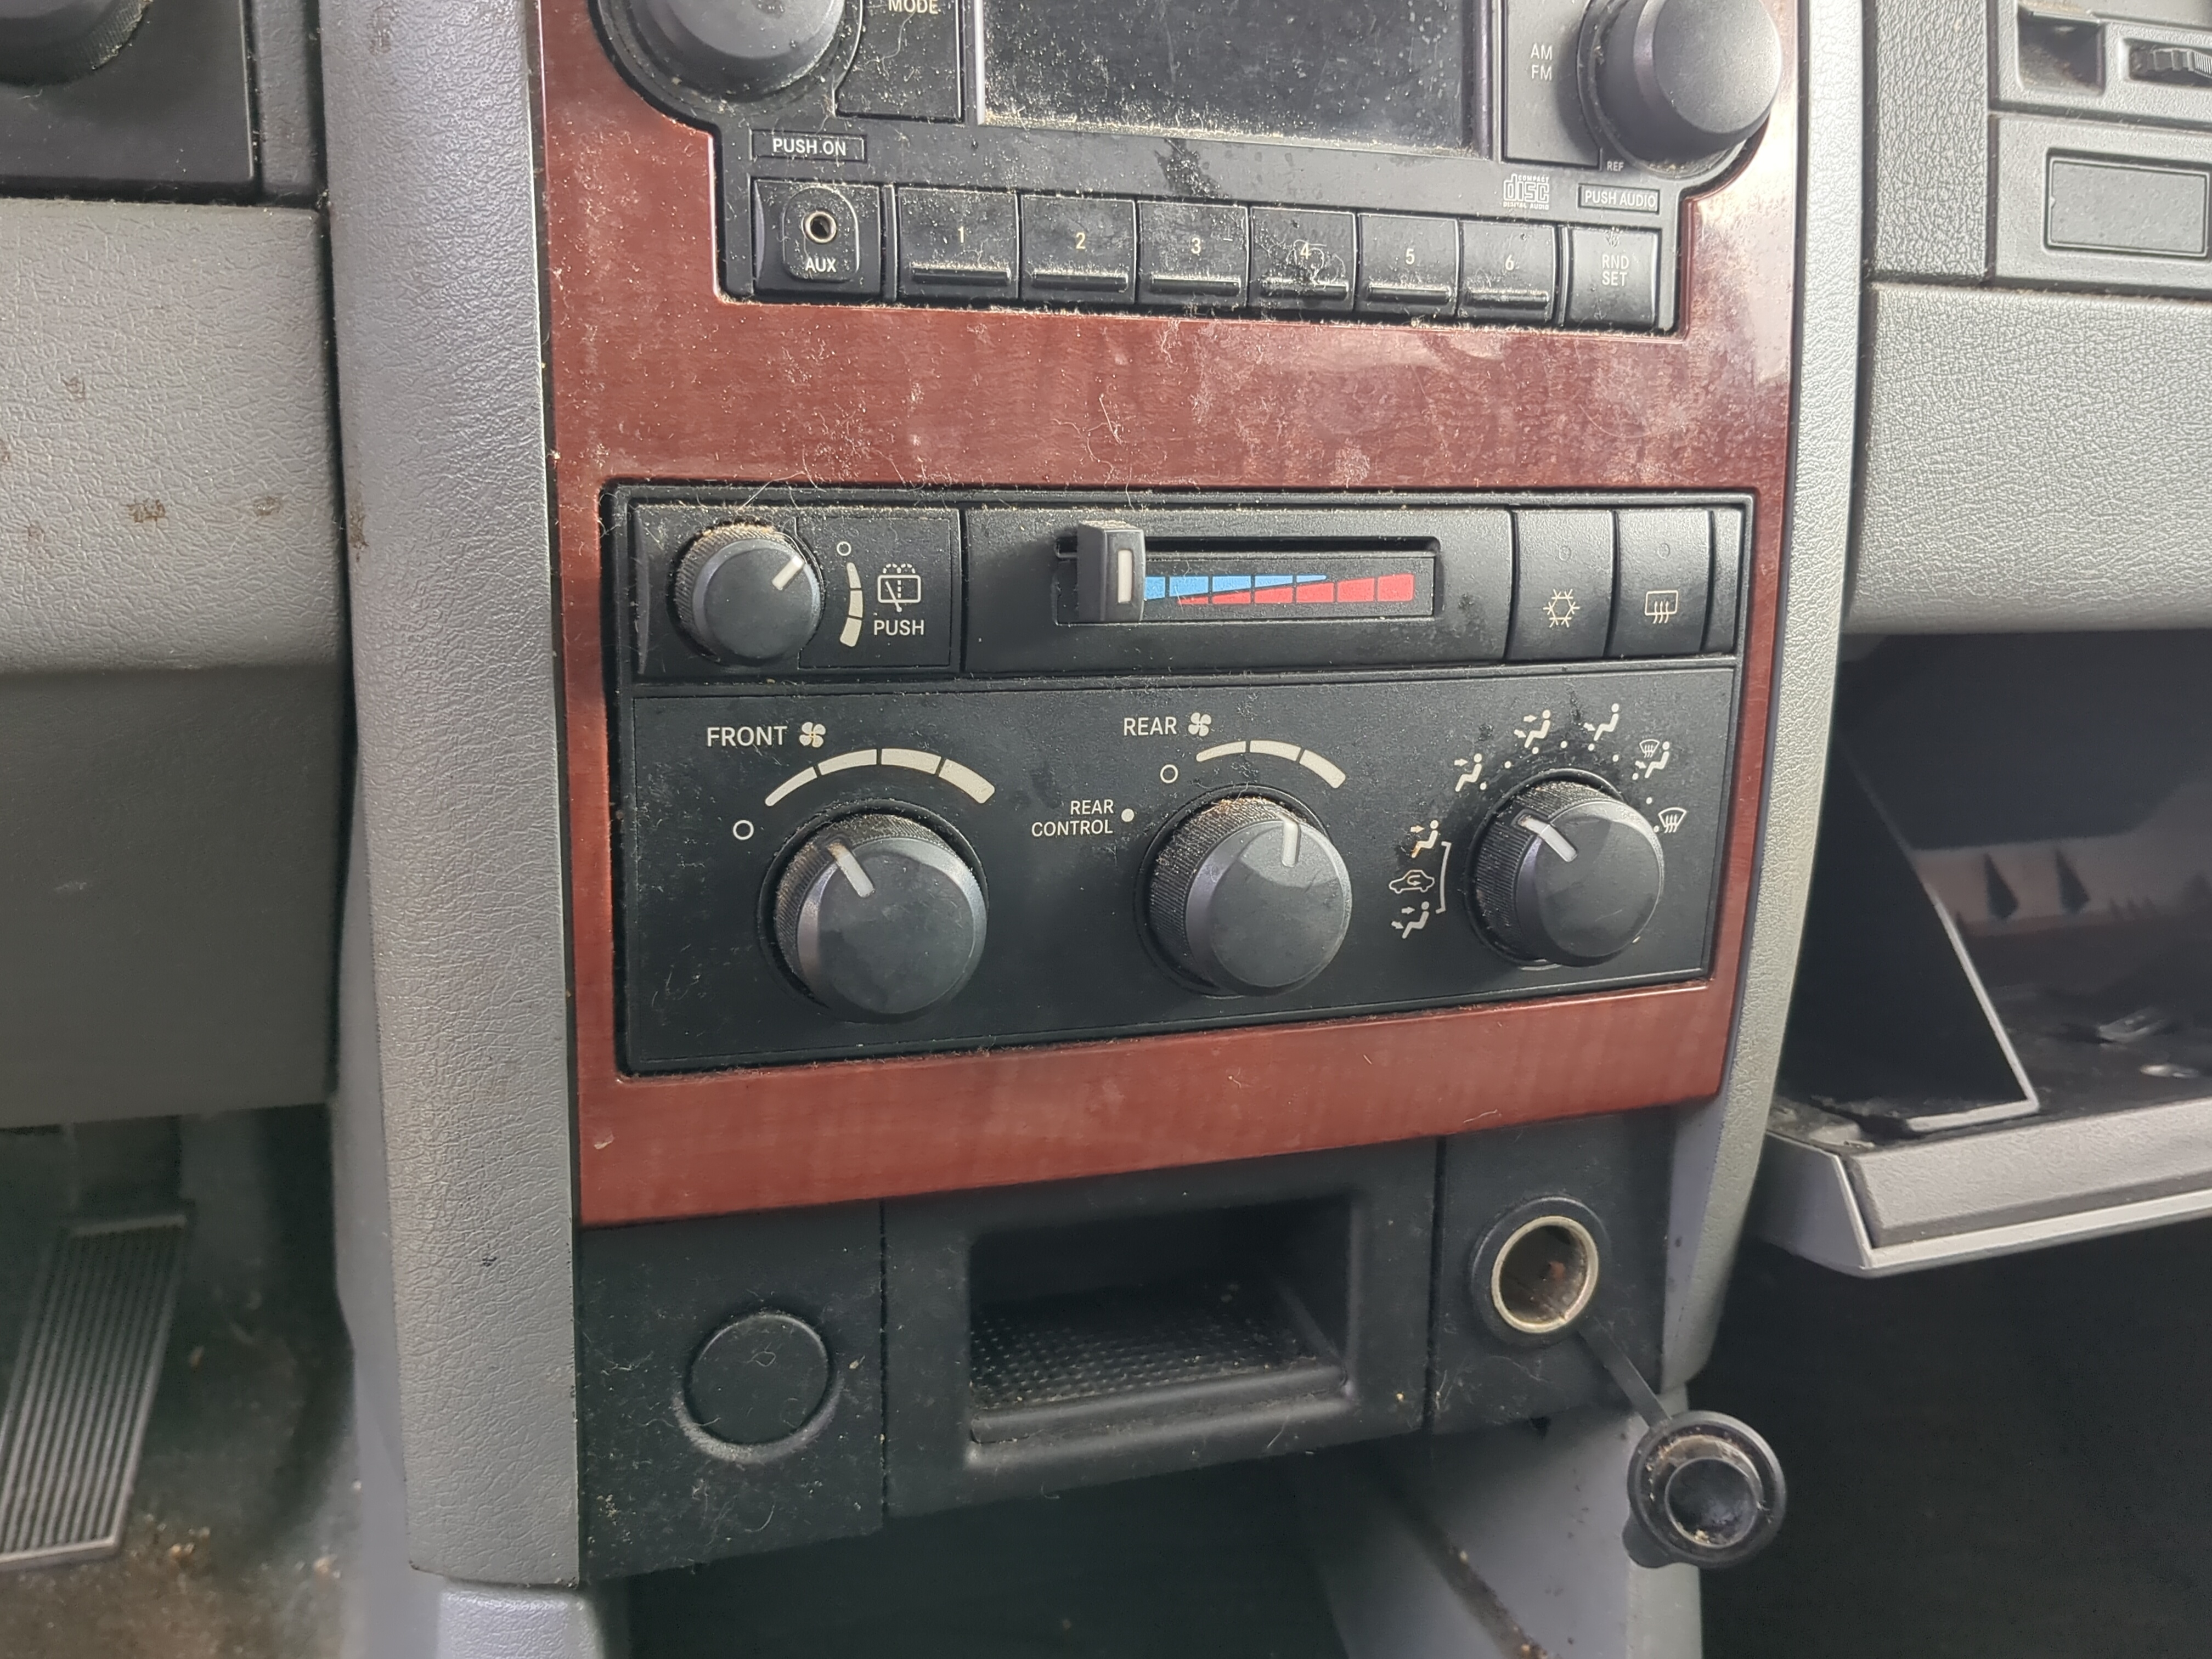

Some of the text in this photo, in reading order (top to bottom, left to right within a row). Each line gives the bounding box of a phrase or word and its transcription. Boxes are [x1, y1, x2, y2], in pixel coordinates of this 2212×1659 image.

[888, 0, 939, 15] MODE
[1531, 44, 1553, 60] AM
[1531, 65, 1553, 81] FM
[773, 138, 847, 156] PUSH ON
[1606, 161, 1624, 172] REF
[1517, 175, 1550, 183] COMPACT
[1584, 190, 1657, 208] PUSH AUDIO
[958, 226, 964, 243] 1
[1076, 232, 1086, 250] 2
[1191, 237, 1201, 254] 3
[1300, 242, 1311, 259] 4
[1405, 248, 1415, 265] 5
[1505, 255, 1515, 271] 6
[1601, 254, 1629, 270] RND
[805, 257, 837, 274] AUX
[1601, 270, 1628, 286] SET
[873, 619, 925, 636] PUSH
[1124, 716, 1177, 736] REAR
[707, 726, 787, 748] FRONT
[1070, 799, 1114, 815] REAR
[1031, 819, 1114, 837] CONTROL
